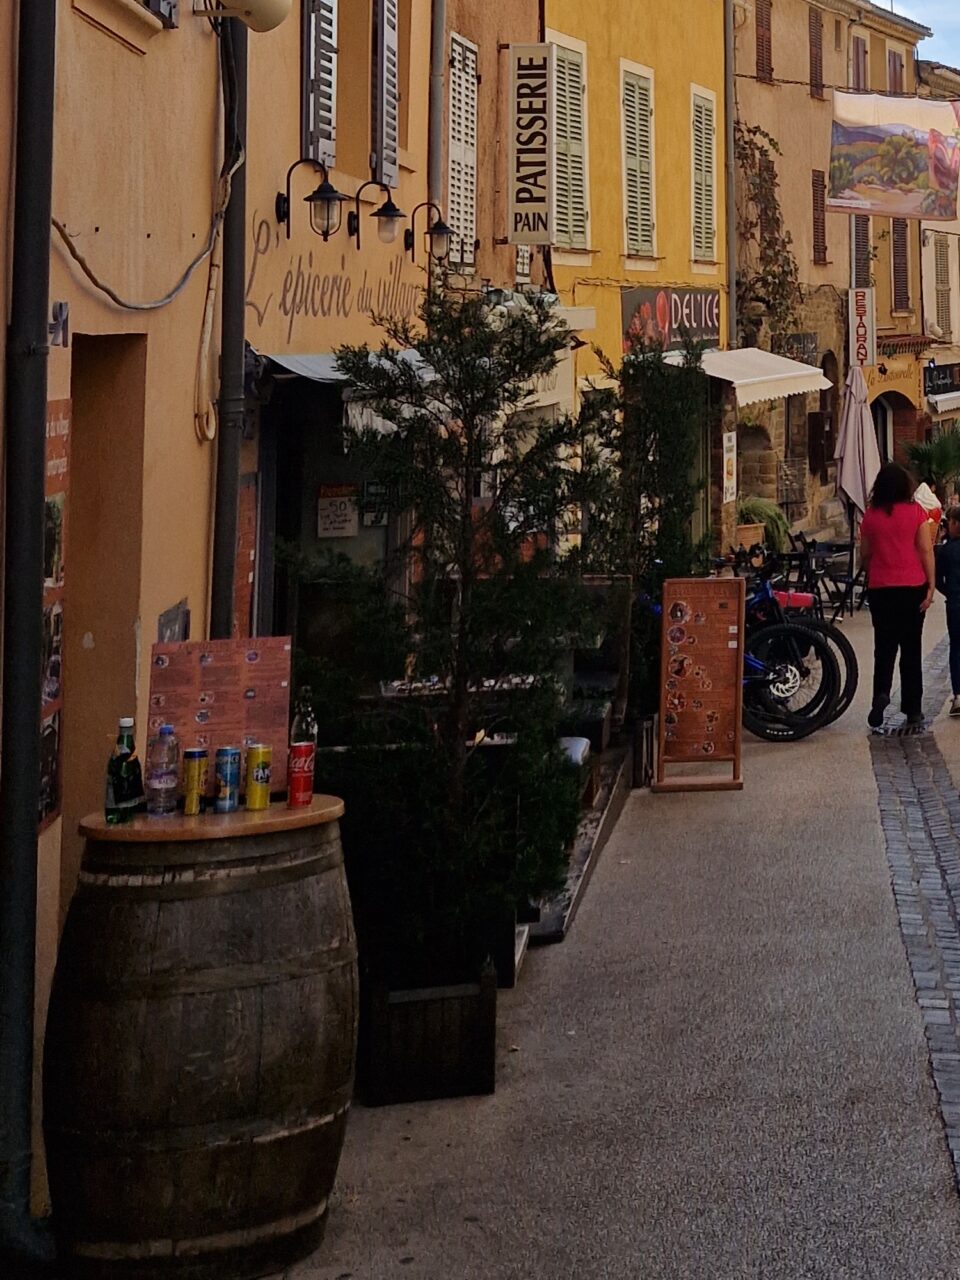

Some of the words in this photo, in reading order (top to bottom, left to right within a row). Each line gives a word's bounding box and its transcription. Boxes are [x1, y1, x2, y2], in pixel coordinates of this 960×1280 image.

[516, 57, 548, 204] PATISSERIE
[514, 212, 549, 232] PAIN
[357, 270, 373, 313] du
[671, 293, 720, 329] DEL'ICE
[855, 291, 868, 366] RESTAURANT
